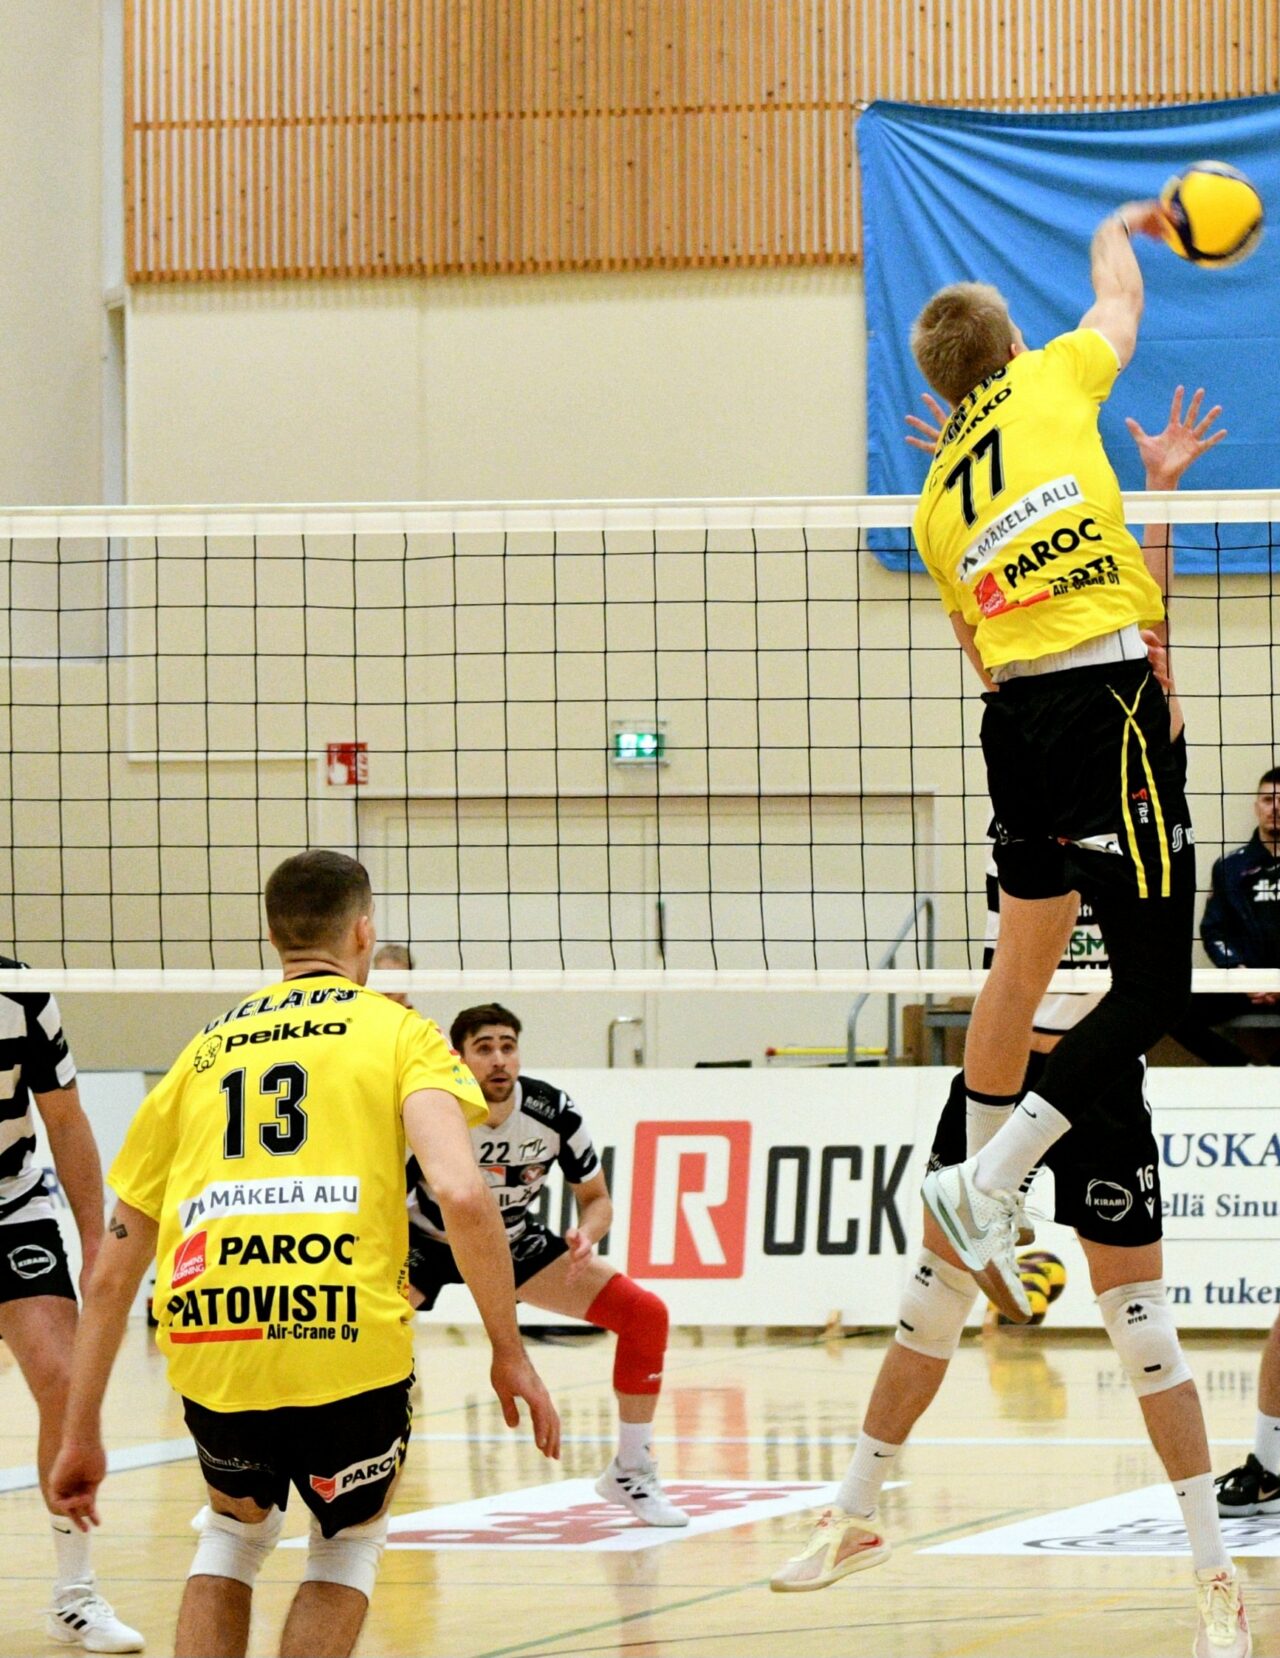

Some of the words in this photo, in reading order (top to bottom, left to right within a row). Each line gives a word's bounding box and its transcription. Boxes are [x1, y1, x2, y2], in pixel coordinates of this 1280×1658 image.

[944, 424, 1005, 531] 77
[977, 497, 1038, 558] MÄKELÄ
[1043, 481, 1080, 508] ALU
[1003, 518, 1103, 589] PAROC
[224, 1019, 348, 1053] peikko
[220, 1061, 308, 1160] 13
[479, 1141, 511, 1164] 22
[209, 1181, 306, 1209] MÄKELÄ
[313, 1184, 359, 1205] ALU
[1136, 1164, 1154, 1192] 16
[1093, 1197, 1126, 1207] KIRAMI
[218, 1232, 354, 1267] PAROC
[165, 1284, 358, 1328] PATOVISTI
[266, 1324, 336, 1342] Air-Crane
[341, 1324, 359, 1343] Oy
